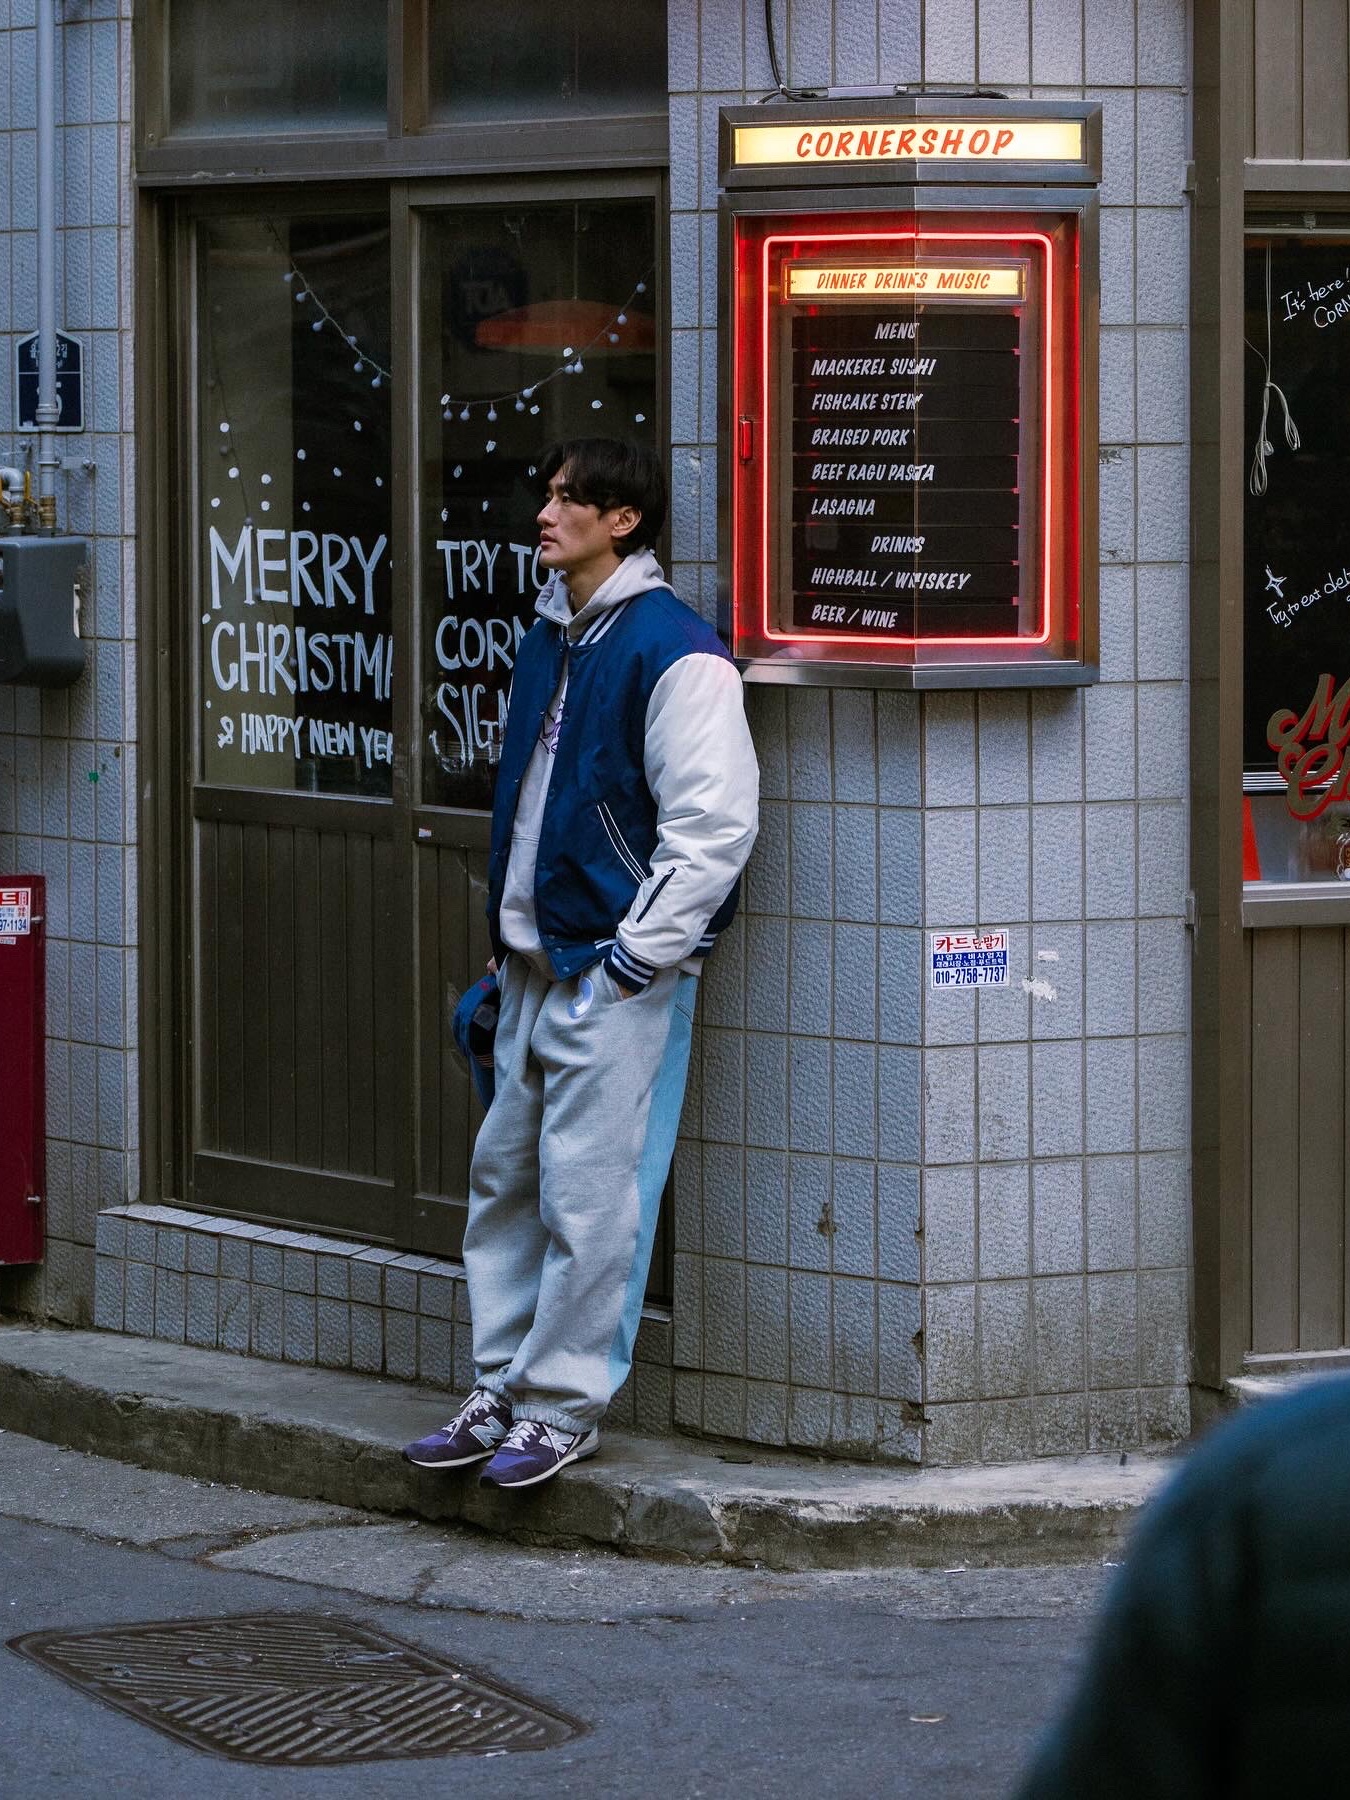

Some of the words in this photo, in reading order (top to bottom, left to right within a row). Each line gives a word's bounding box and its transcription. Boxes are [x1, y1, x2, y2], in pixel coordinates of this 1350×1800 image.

[796, 129, 1014, 158] CORNERSHOP
[817, 273, 867, 289] DINNER
[937, 272, 991, 290] MUSIC
[811, 358, 886, 376] MACKEREL
[811, 393, 878, 411] FISHCAKE
[811, 428, 869, 446] BRAISED
[872, 429, 909, 446] PORK
[811, 464, 844, 481] BEEF
[847, 464, 886, 481] RAGU
[888, 464, 934, 481] PASTA
[811, 499, 875, 516] LASAGNA
[871, 536, 925, 553] DRINKS
[209, 525, 387, 615] MERRY
[436, 540, 501, 600] TRY
[811, 568, 877, 586] HIGHBALL
[1288, 603, 1300, 615] to
[1301, 589, 1322, 607] eat
[811, 604, 846, 622] BEER
[861, 609, 898, 628] WINE
[211, 621, 393, 701] CHRISTM
[241, 712, 303, 759] HAPPY
[309, 718, 355, 756] NEW
[936, 968, 1005, 984] 010-2758-7737
[469, 1416, 509, 1448] N
